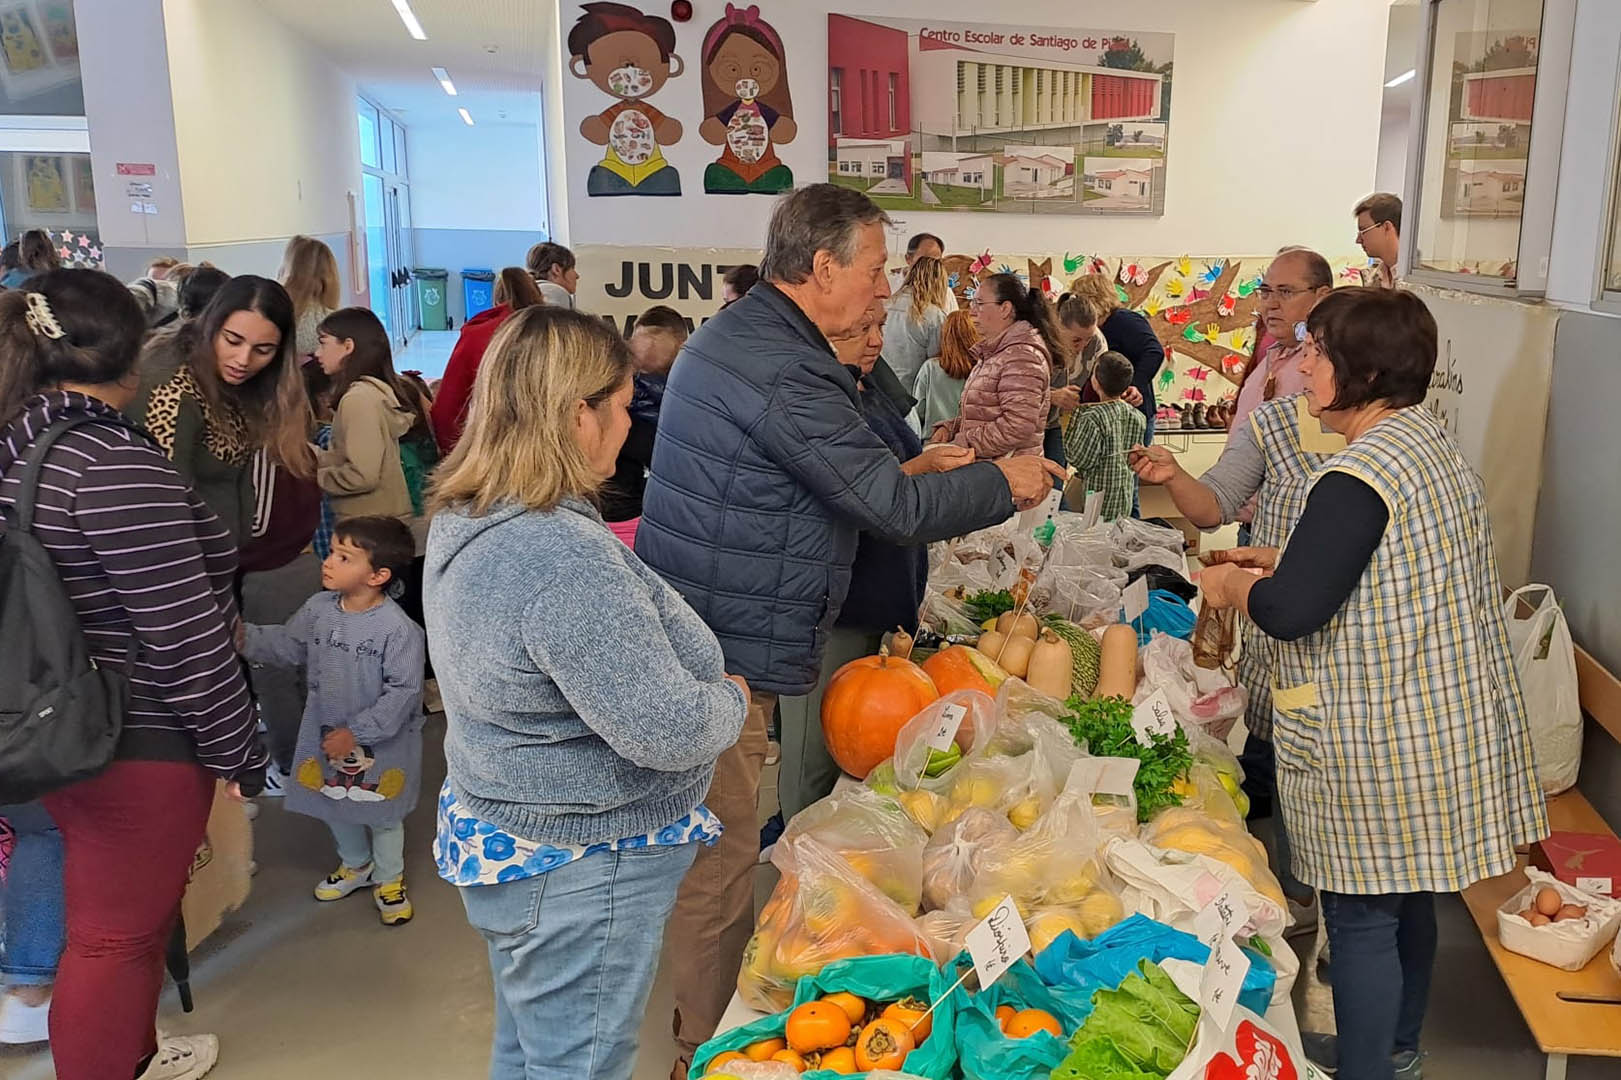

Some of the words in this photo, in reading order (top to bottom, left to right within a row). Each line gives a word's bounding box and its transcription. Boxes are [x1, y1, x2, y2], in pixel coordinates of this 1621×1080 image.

[919, 27, 960, 42] Centro
[964, 30, 1005, 45] Escolar
[1009, 33, 1025, 46] de
[1030, 33, 1078, 51] Santiago
[1082, 36, 1097, 49] de
